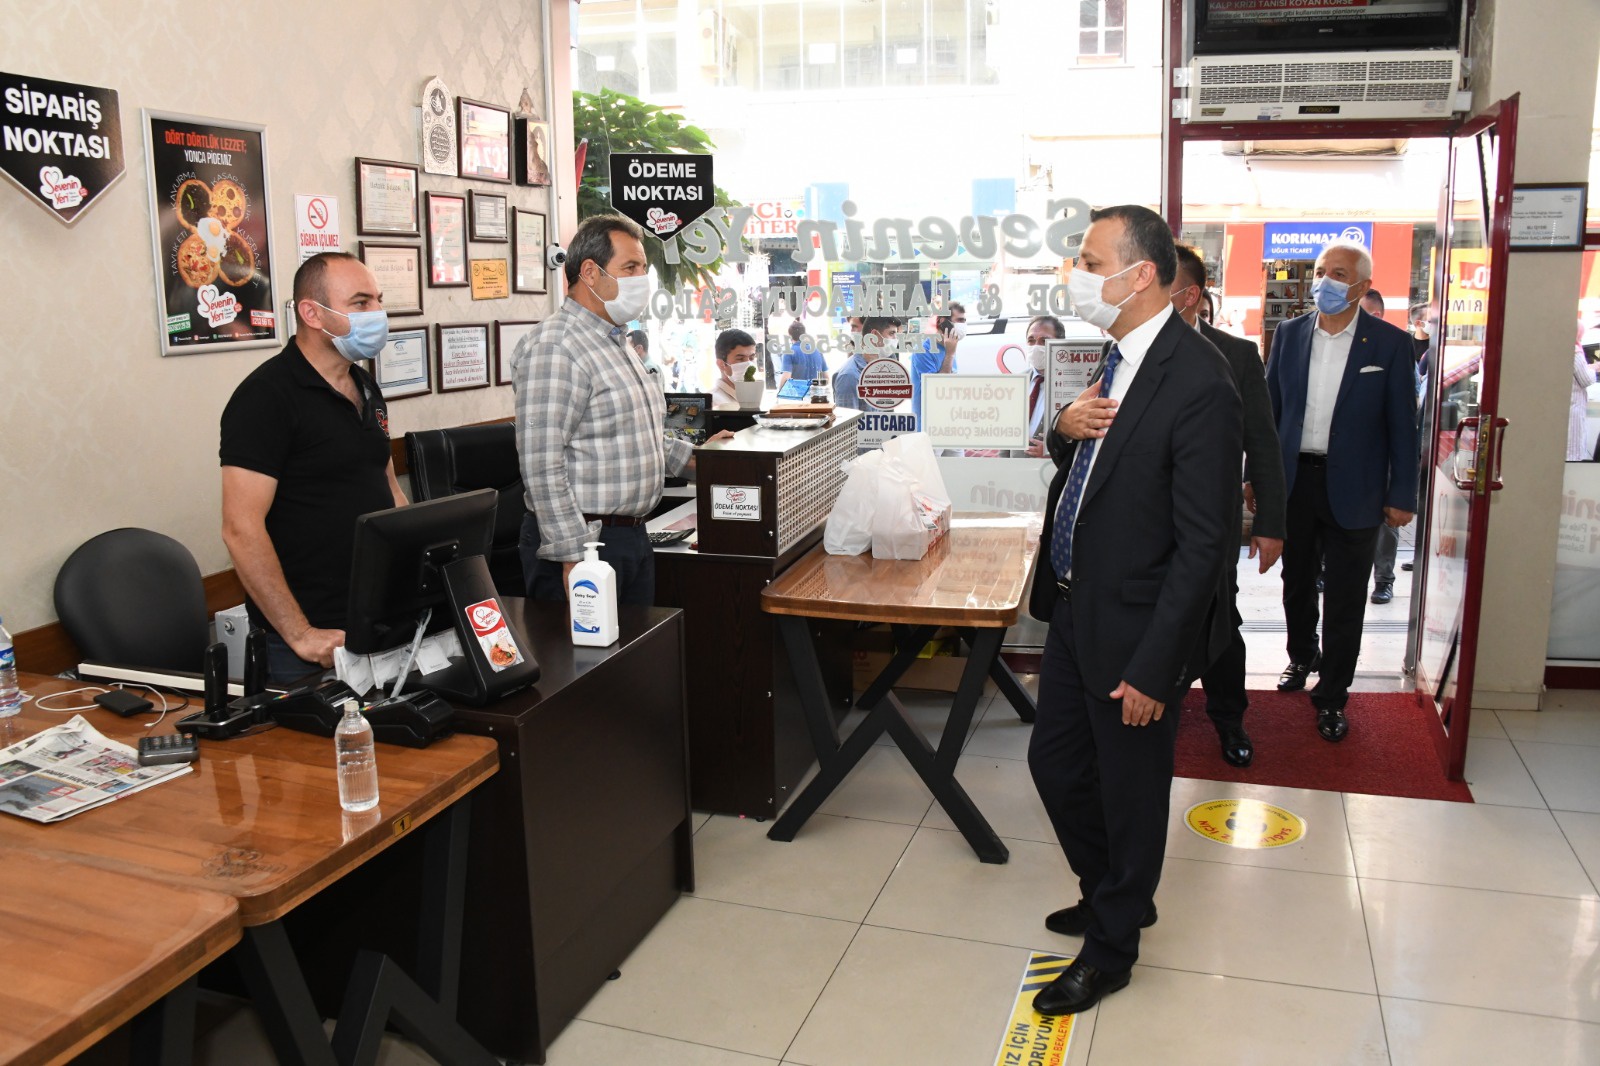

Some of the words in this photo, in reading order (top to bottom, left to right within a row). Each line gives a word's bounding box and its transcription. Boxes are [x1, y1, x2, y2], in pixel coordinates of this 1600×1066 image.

[5, 83, 102, 130] SİPARİŞ
[3, 125, 110, 160] NOKTASI
[165, 128, 185, 145] DÖRT
[186, 132, 220, 150] DÖRTLÜK
[184, 150, 207, 164] YONCA
[207, 150, 232, 166] PİDEMİZ
[628, 159, 696, 178] ÖDEME
[170, 171, 197, 210] KAVURMA
[623, 186, 703, 201] NOKTASI
[1271, 233, 1339, 244] KORKMAZ
[200, 289, 233, 313] Sevenin
[1070, 353, 1081, 363] 14
[1083, 353, 1101, 363] KU
[858, 415, 916, 431] SETCARD
[714, 502, 734, 511] ÖDEME
[1198, 820, 1220, 835] İÇİN
[1006, 1023, 1030, 1049] İÇİN
[1028, 1016, 1055, 1066] ORUYUN
